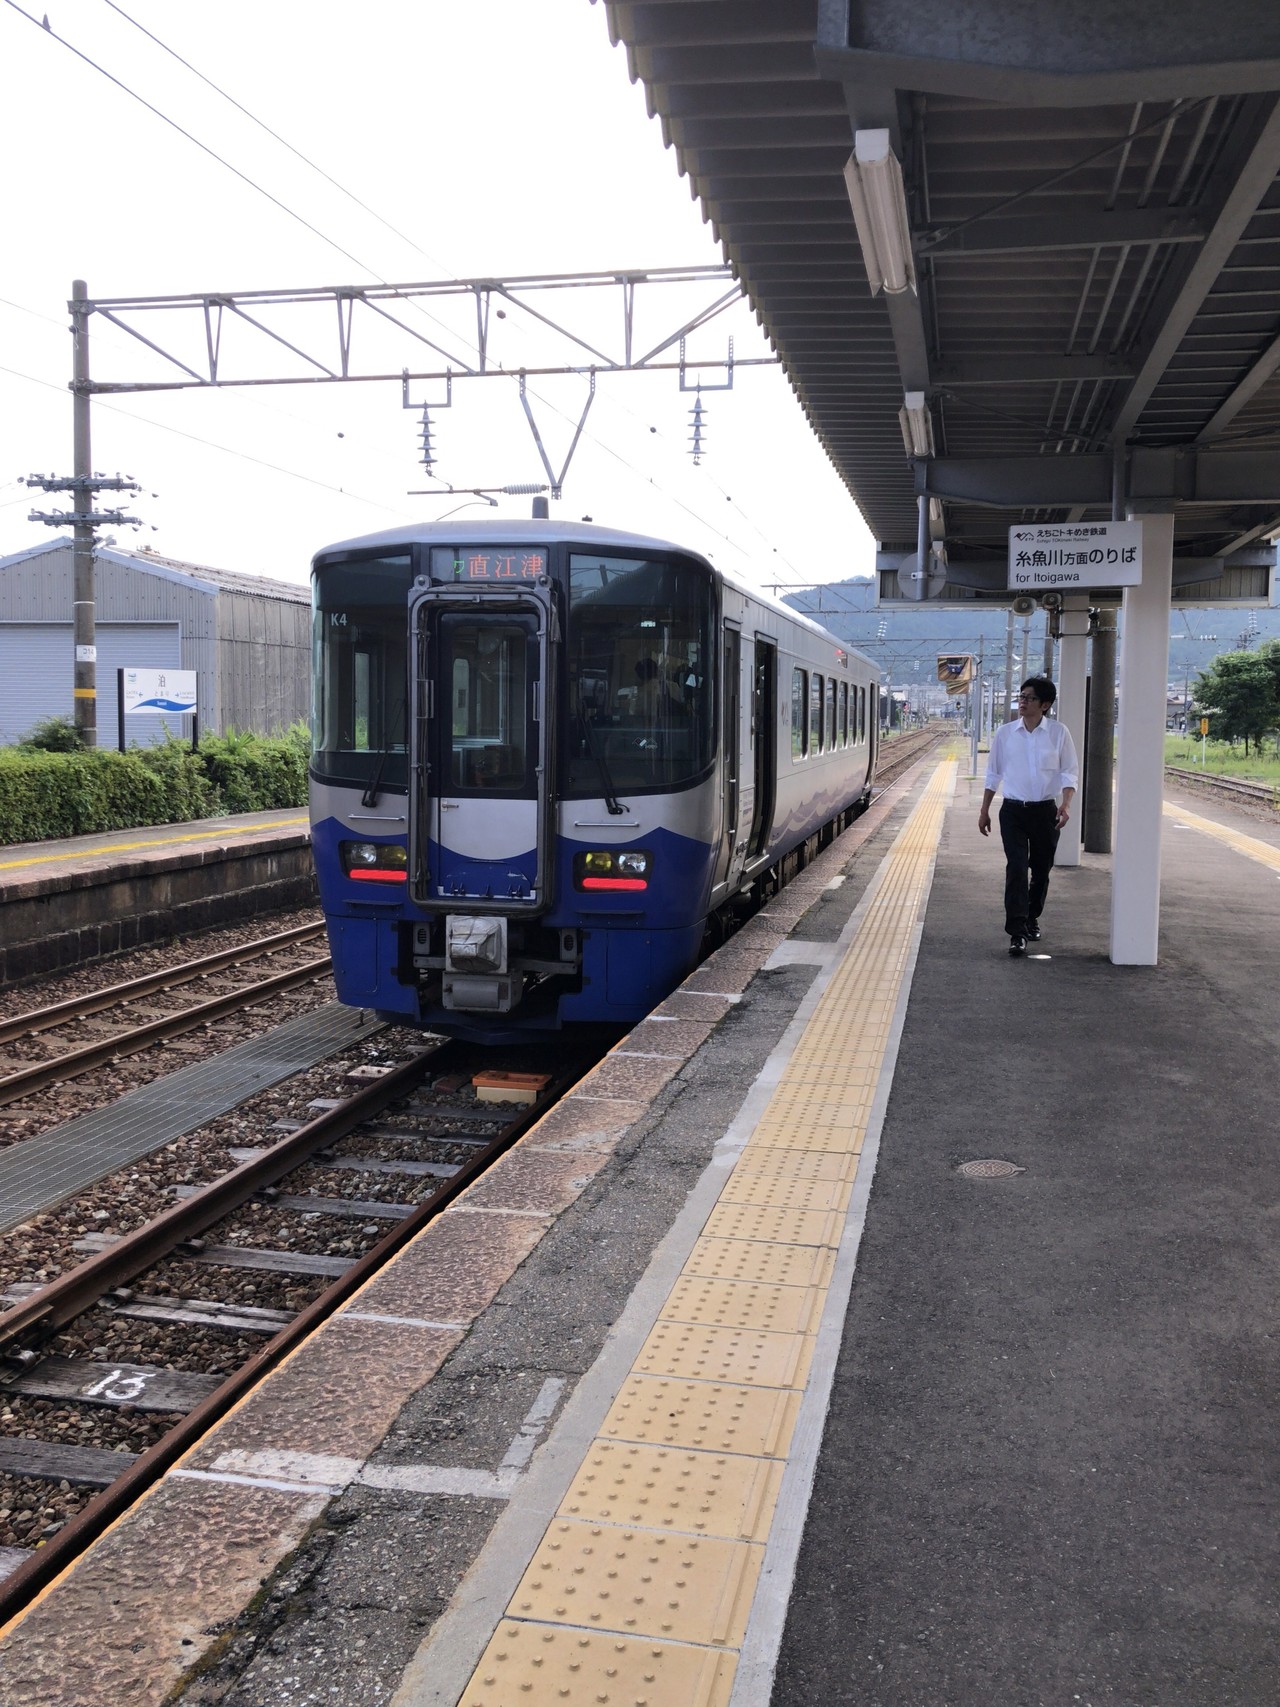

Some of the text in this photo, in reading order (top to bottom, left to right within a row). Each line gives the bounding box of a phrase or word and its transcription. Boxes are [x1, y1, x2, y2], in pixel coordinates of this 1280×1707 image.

[1037, 527, 1107, 538] えちごトキめき鉄道
[1016, 546, 1137, 567] 糸魚川方面のりば
[468, 554, 544, 578] 直江津
[1016, 572, 1080, 584] for Itoigawa
[331, 613, 347, 626] K4
